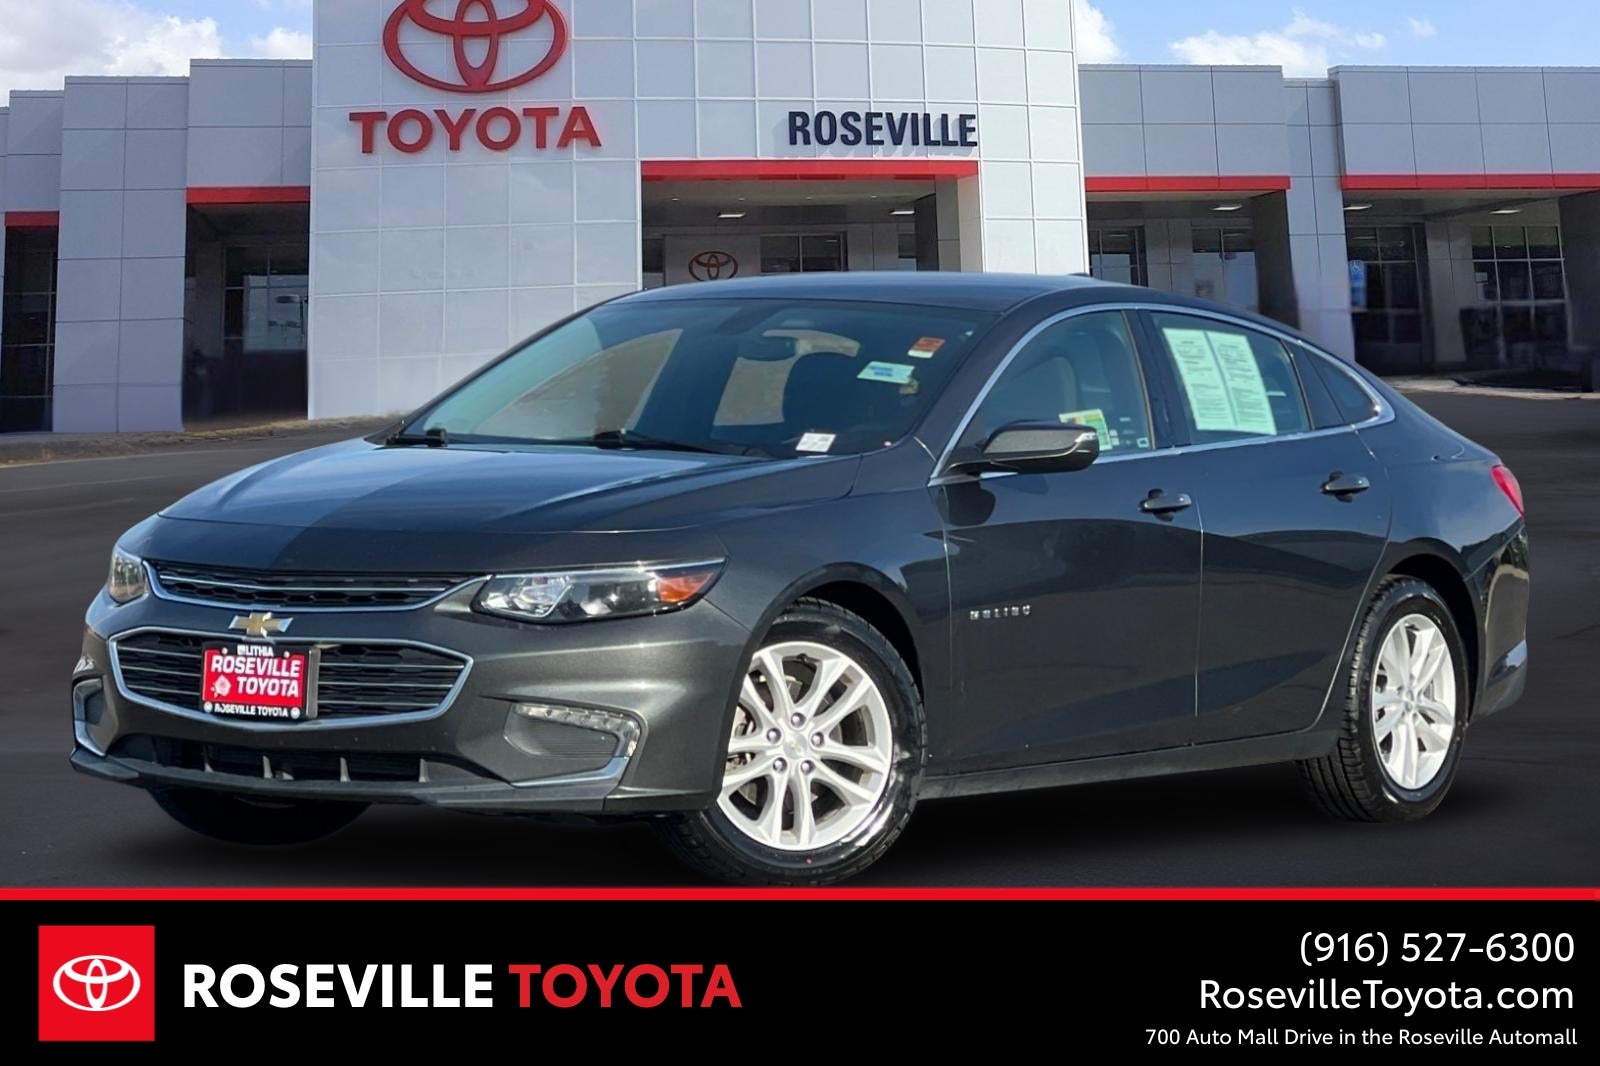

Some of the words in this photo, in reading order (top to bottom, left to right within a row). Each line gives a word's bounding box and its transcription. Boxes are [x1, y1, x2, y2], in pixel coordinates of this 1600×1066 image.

[349, 106, 602, 154] TOYOTA
[788, 111, 978, 147] ROSEVILLE
[210, 655, 302, 677] ROSEVILLE
[236, 676, 299, 698] TOYOTA
[214, 703, 256, 715] ROSEVILLE
[257, 706, 289, 717] TOYOTA
